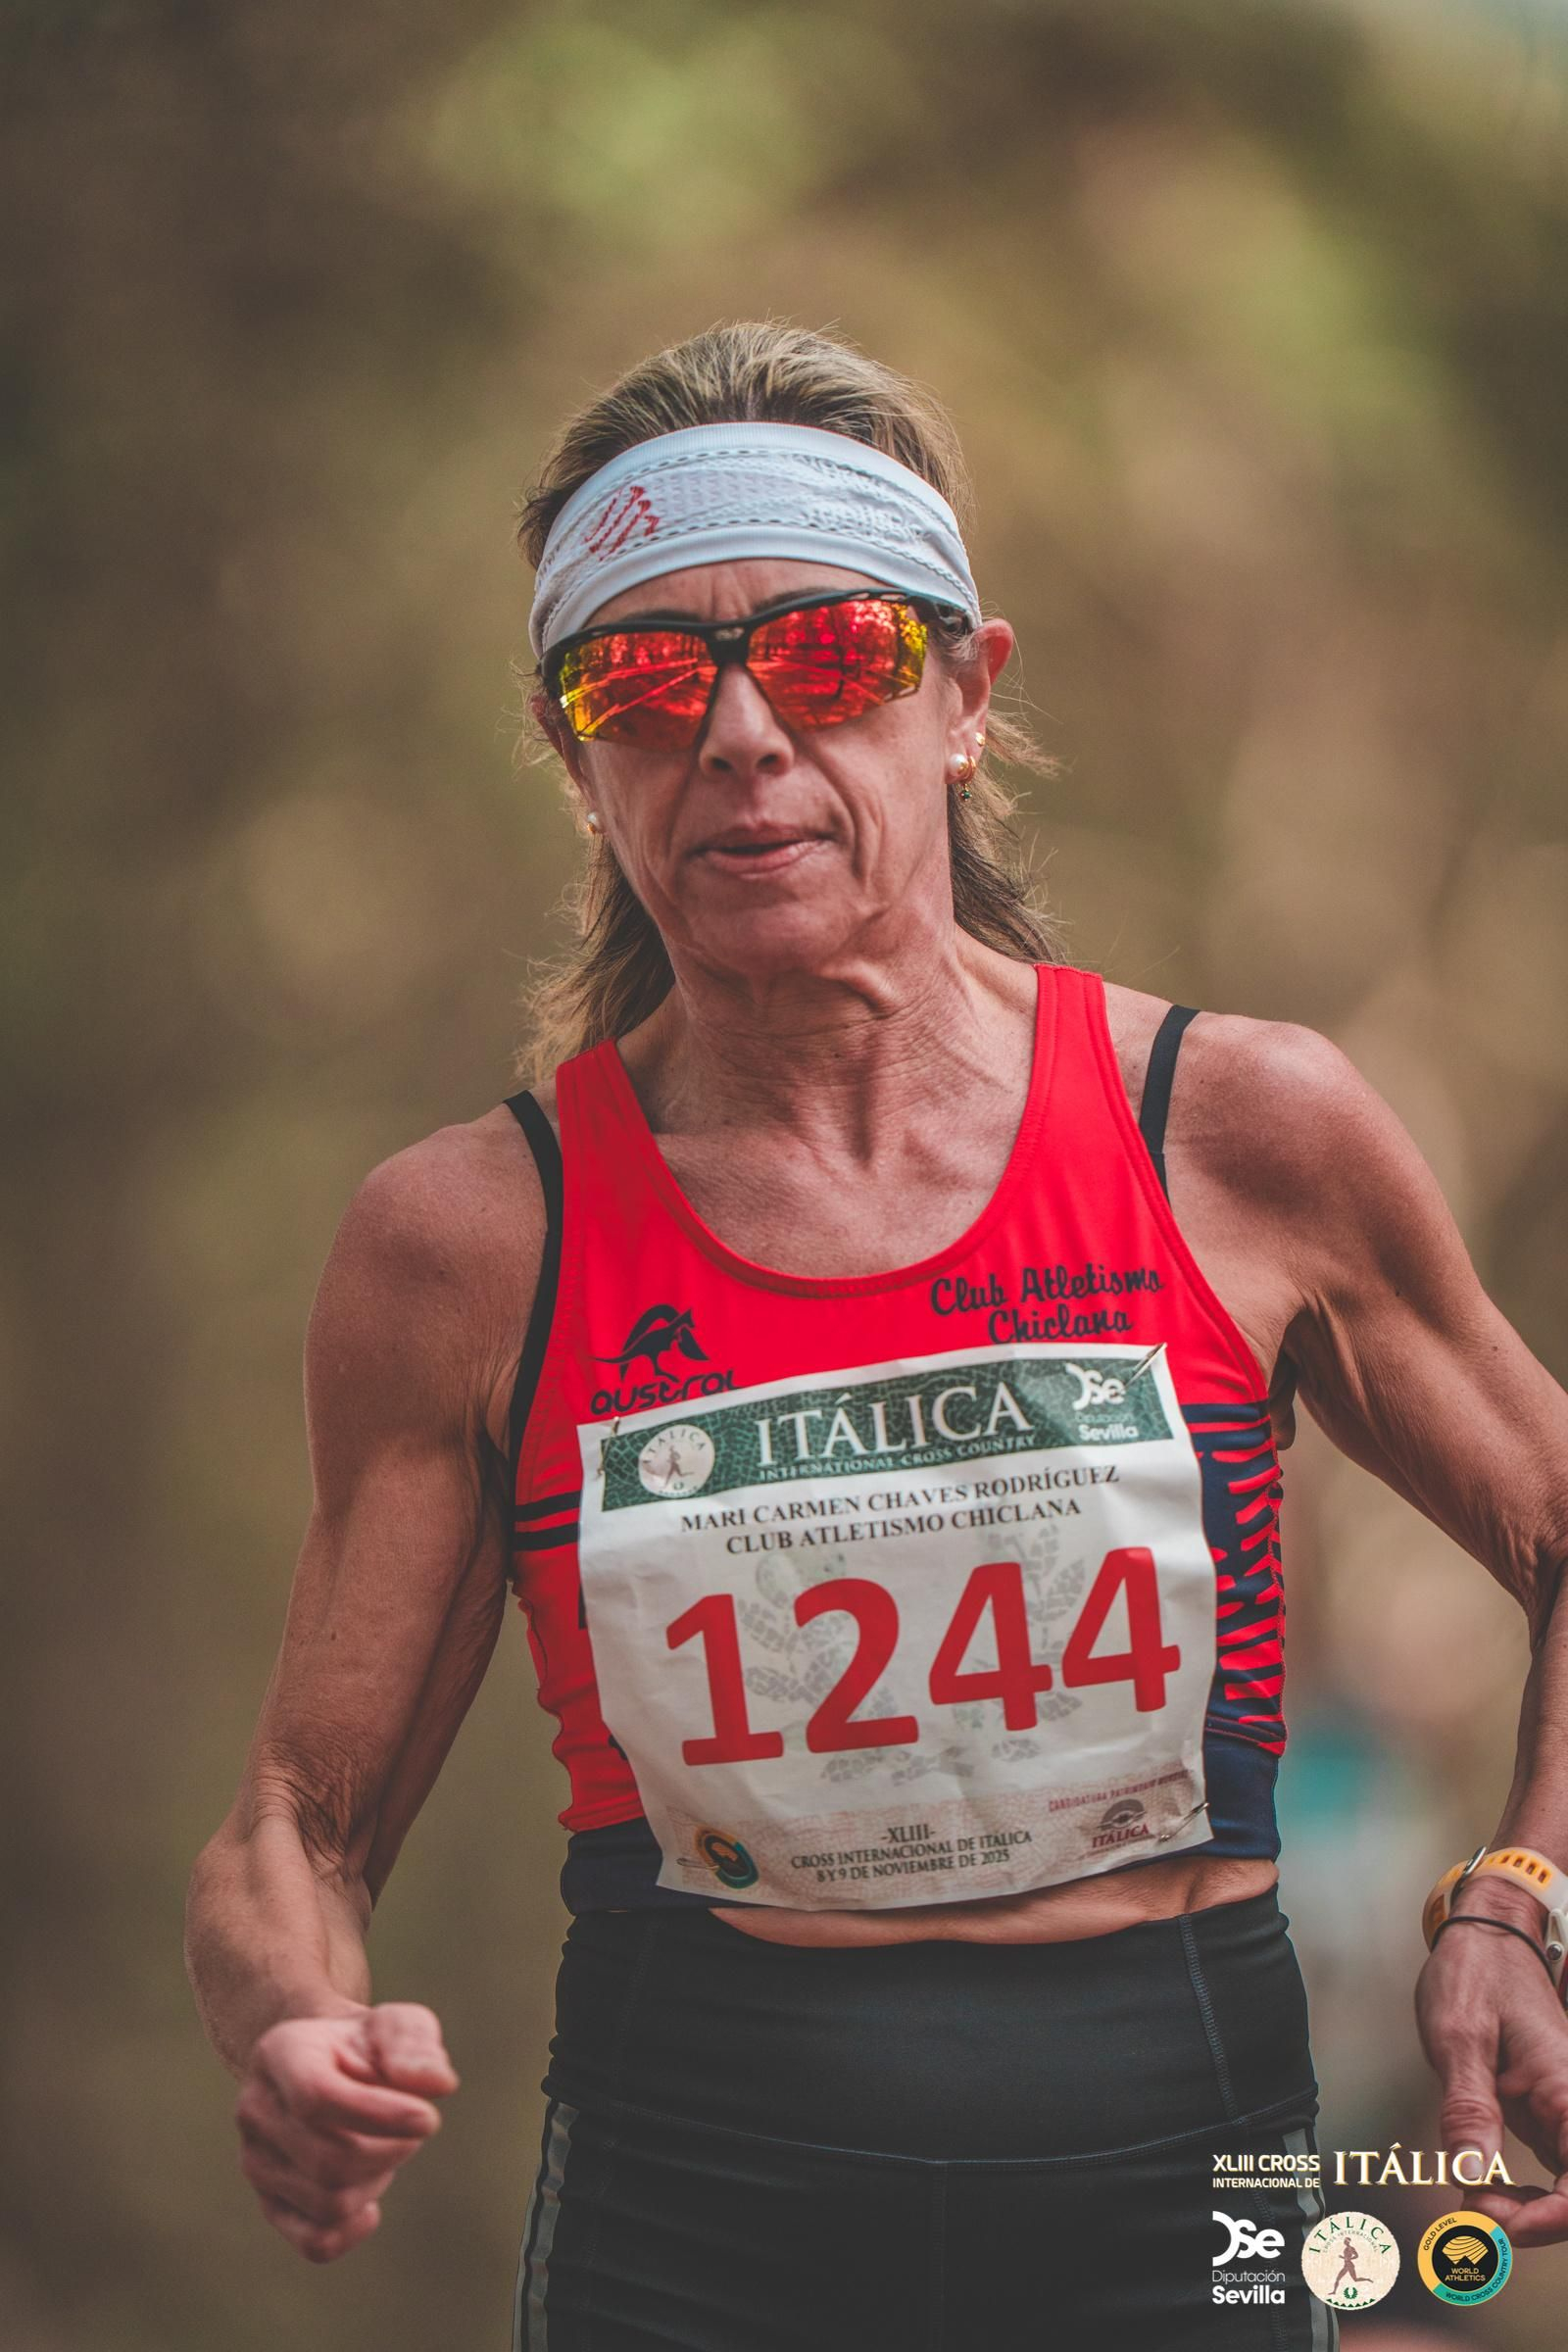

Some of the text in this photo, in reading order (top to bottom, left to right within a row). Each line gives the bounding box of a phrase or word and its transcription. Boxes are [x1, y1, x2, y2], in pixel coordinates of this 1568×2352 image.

[931, 1263, 1163, 1316] Club Atletismo
[988, 1304, 1132, 1346] Chiclana
[590, 1369, 740, 1415] austral
[755, 1381, 1035, 1468] ITÁLICA
[1079, 1423, 1140, 1441] Sevilla
[760, 1434, 1036, 1481] INTERNATIONAL CROSS COUNTRY
[681, 1465, 1120, 1533] MARI CARMEN CHAVES RODRÍGUEZ
[726, 1498, 1082, 1555] CLUB ATLETISMO CHICLANA
[665, 1545, 1181, 1766] 1244
[792, 1852, 838, 1870] CROSS
[838, 1840, 954, 1863] INTERNACIONAL
[957, 1836, 976, 1852] DE
[1093, 1823, 1151, 1849] ITÁLICA
[817, 1848, 1010, 1883] 8 Y 9 DE NOVIEMBRE DE 2025
